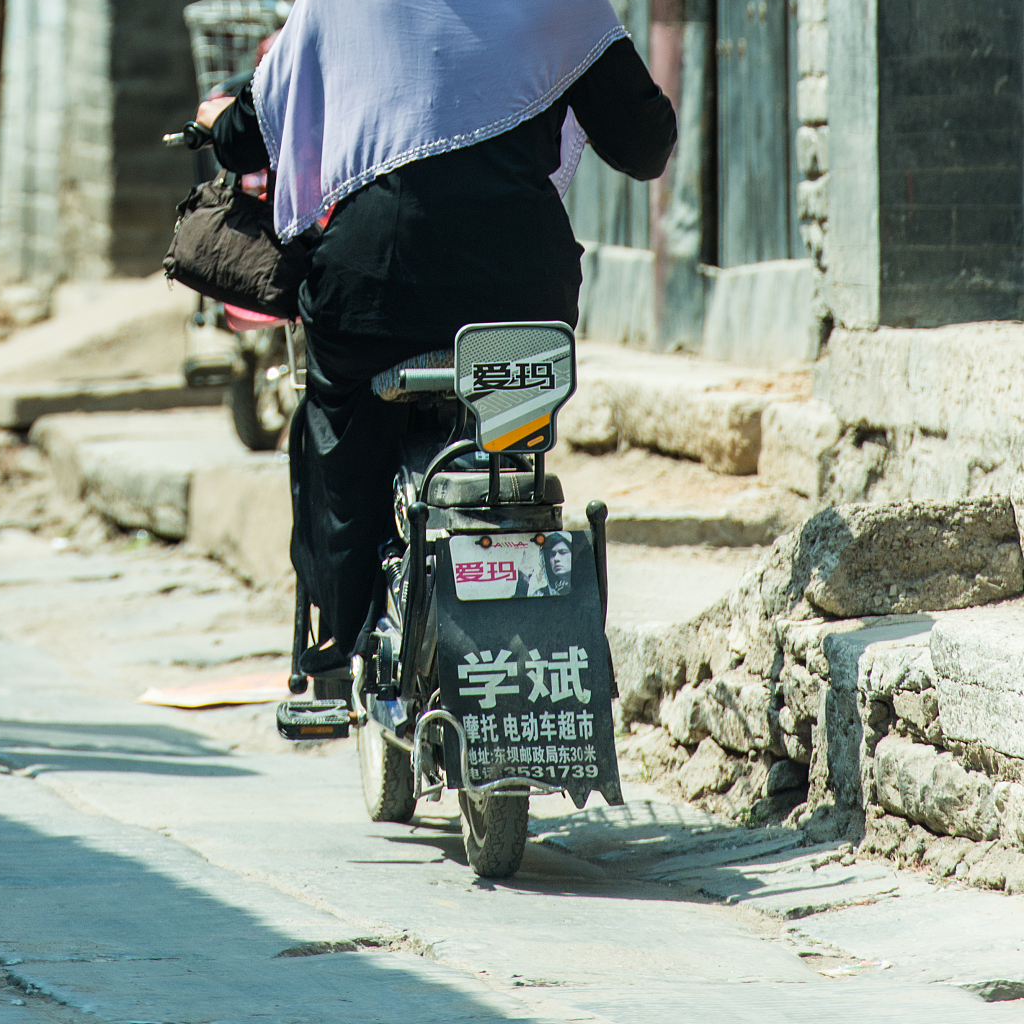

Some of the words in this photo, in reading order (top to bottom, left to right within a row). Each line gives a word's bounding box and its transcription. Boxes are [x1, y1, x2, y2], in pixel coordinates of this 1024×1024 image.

[472, 361, 557, 392] 爱玛
[455, 561, 517, 584] 爱玛
[457, 645, 592, 709] 学斌
[462, 713, 499, 744] 摩托
[503, 710, 594, 743] 电动车超市
